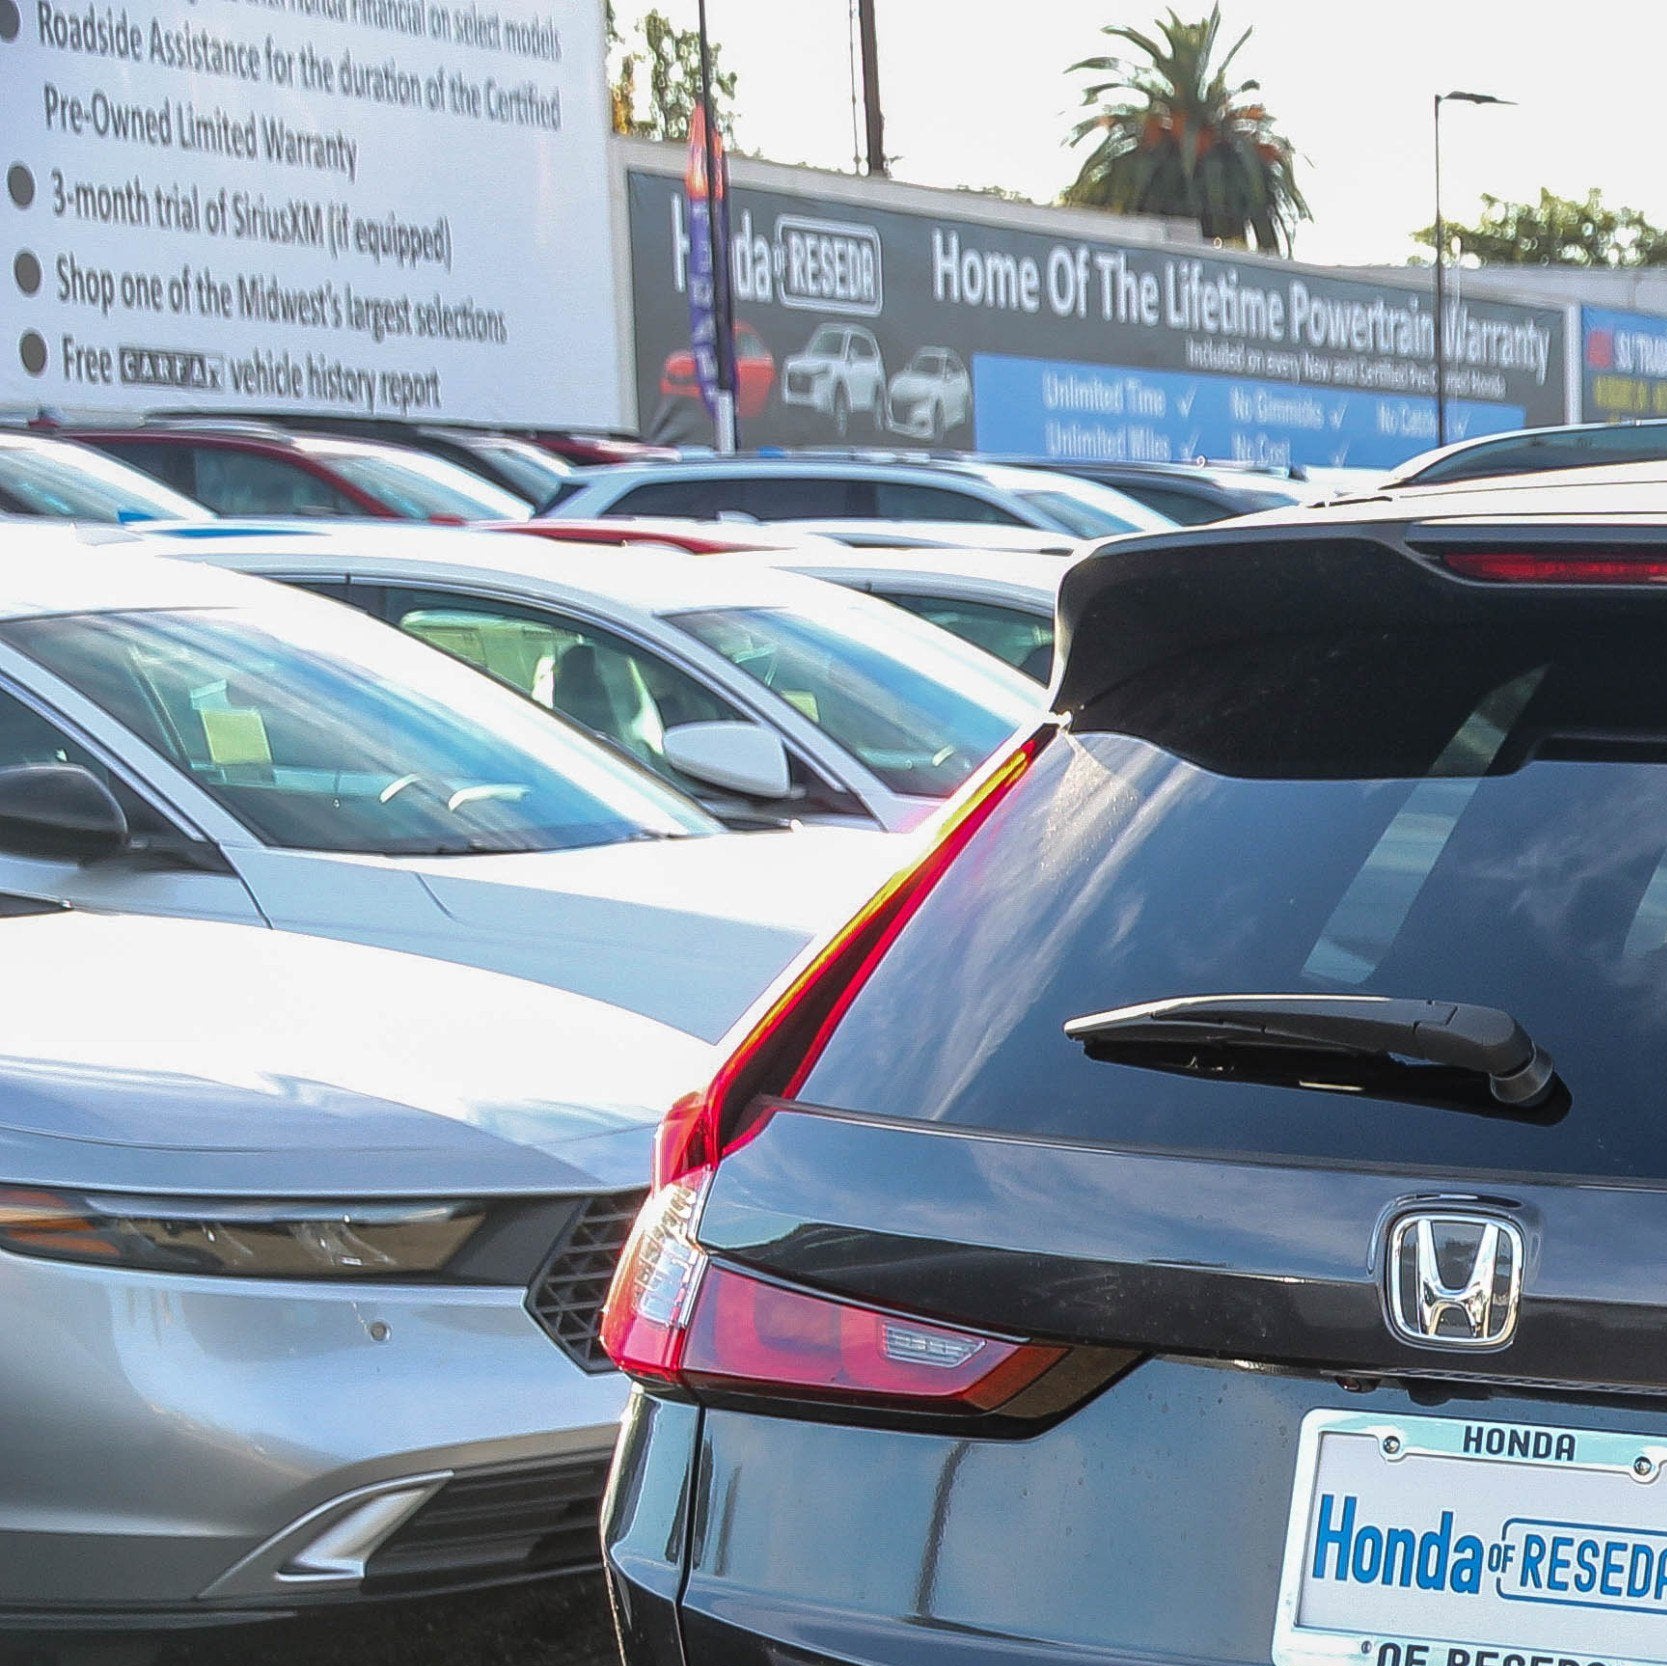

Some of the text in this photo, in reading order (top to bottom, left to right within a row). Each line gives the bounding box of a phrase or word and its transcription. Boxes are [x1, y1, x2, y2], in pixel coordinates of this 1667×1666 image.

[37, 0, 562, 132] Roadside Assistance for the duration of the Certified
[43, 81, 357, 185] Pre-Owned Limited Warranty
[50, 168, 453, 276] 3-month trial of SiriusXM (if equipped)
[671, 191, 773, 303] Hda
[787, 230, 876, 300] RESEDA
[56, 251, 508, 346] Shop one of the Midwest's largest selections
[931, 226, 1550, 387] Home Of The Lifetime Powertrain Warranty
[61, 333, 113, 385] Free
[229, 346, 303, 398] vehicle
[305, 350, 378, 415] history
[380, 365, 442, 417] report
[1462, 1424, 1576, 1462] HONDA
[1312, 1492, 1484, 1595] Honda
[1487, 1541, 1516, 1575] OF
